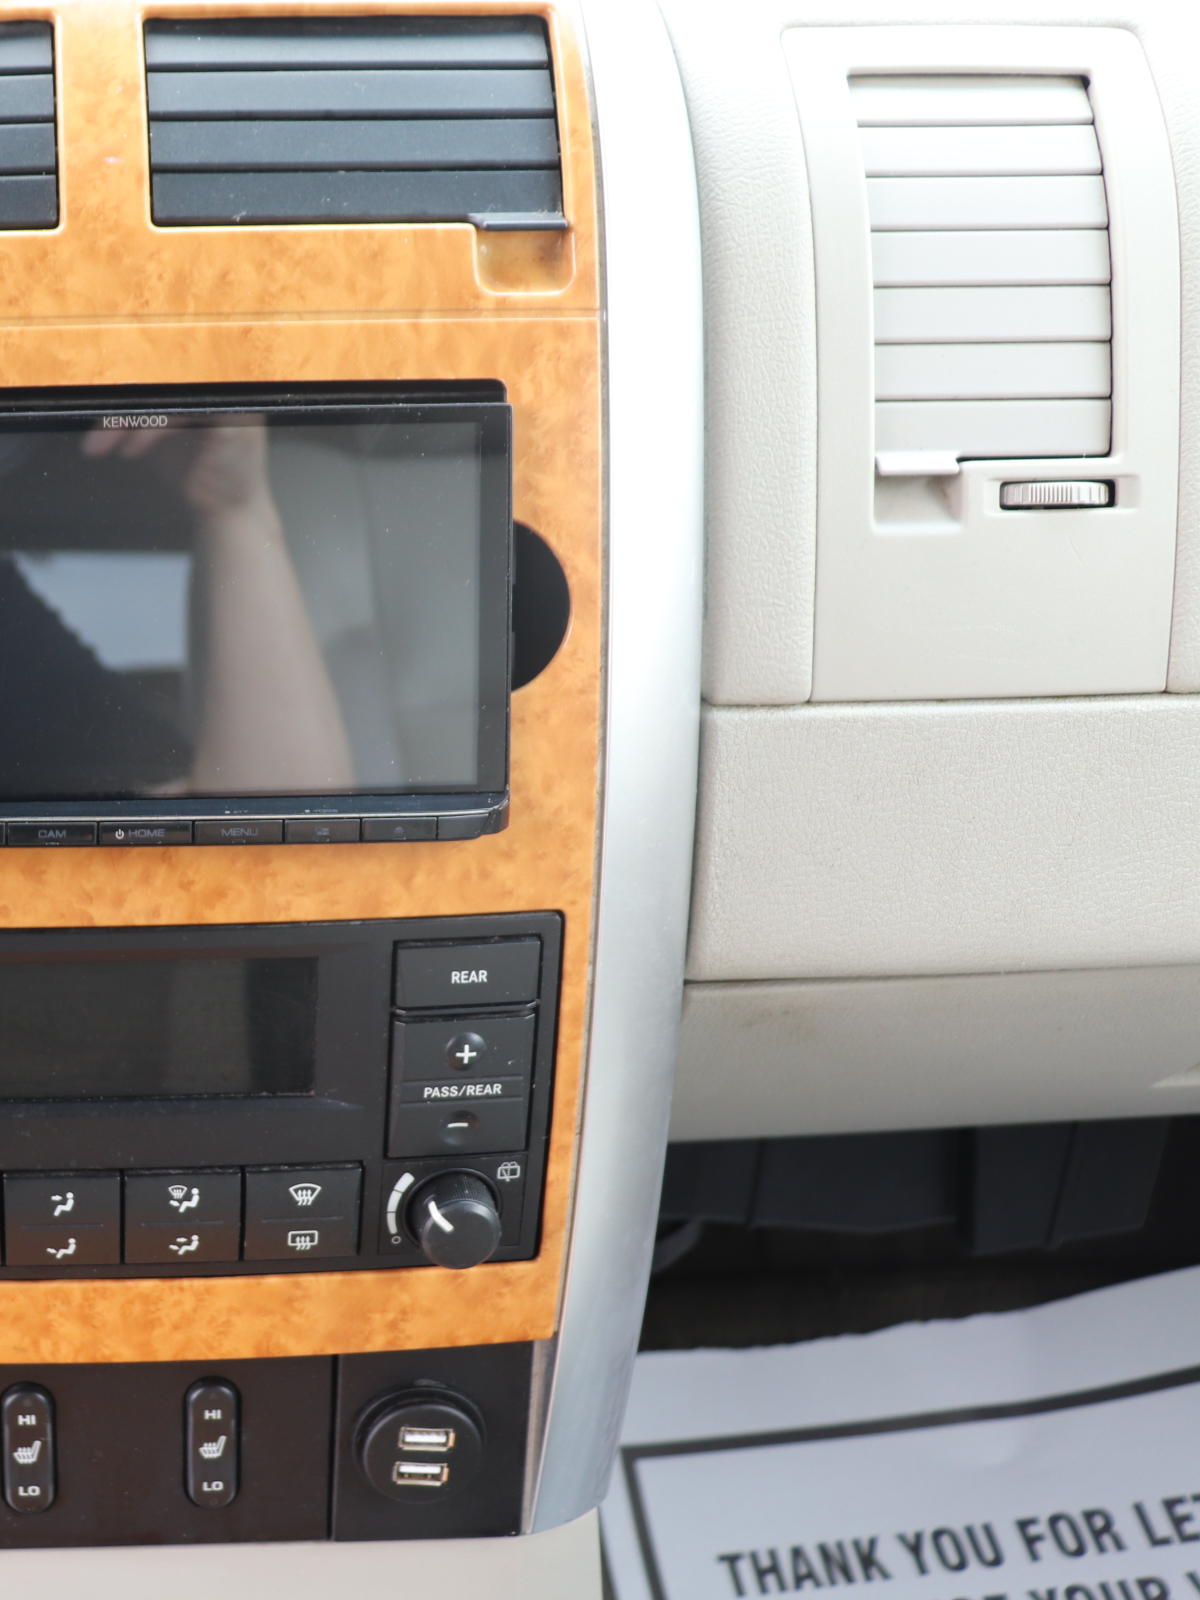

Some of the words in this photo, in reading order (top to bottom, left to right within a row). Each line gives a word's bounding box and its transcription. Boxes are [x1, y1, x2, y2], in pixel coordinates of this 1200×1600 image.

[103, 415, 168, 428] KENWOOD
[38, 829, 67, 838] CAM
[128, 828, 166, 838] HOME
[221, 827, 259, 837] MENU
[451, 969, 488, 984] REAR
[423, 1083, 502, 1099] PASS/REAR
[17, 1415, 36, 1425] HI
[204, 1409, 222, 1420] HI
[18, 1486, 41, 1497] LO
[202, 1480, 224, 1492] LO
[717, 1535, 892, 1598] THANK
[896, 1523, 1005, 1573] YOU
[1015, 1508, 1128, 1562] FOR
